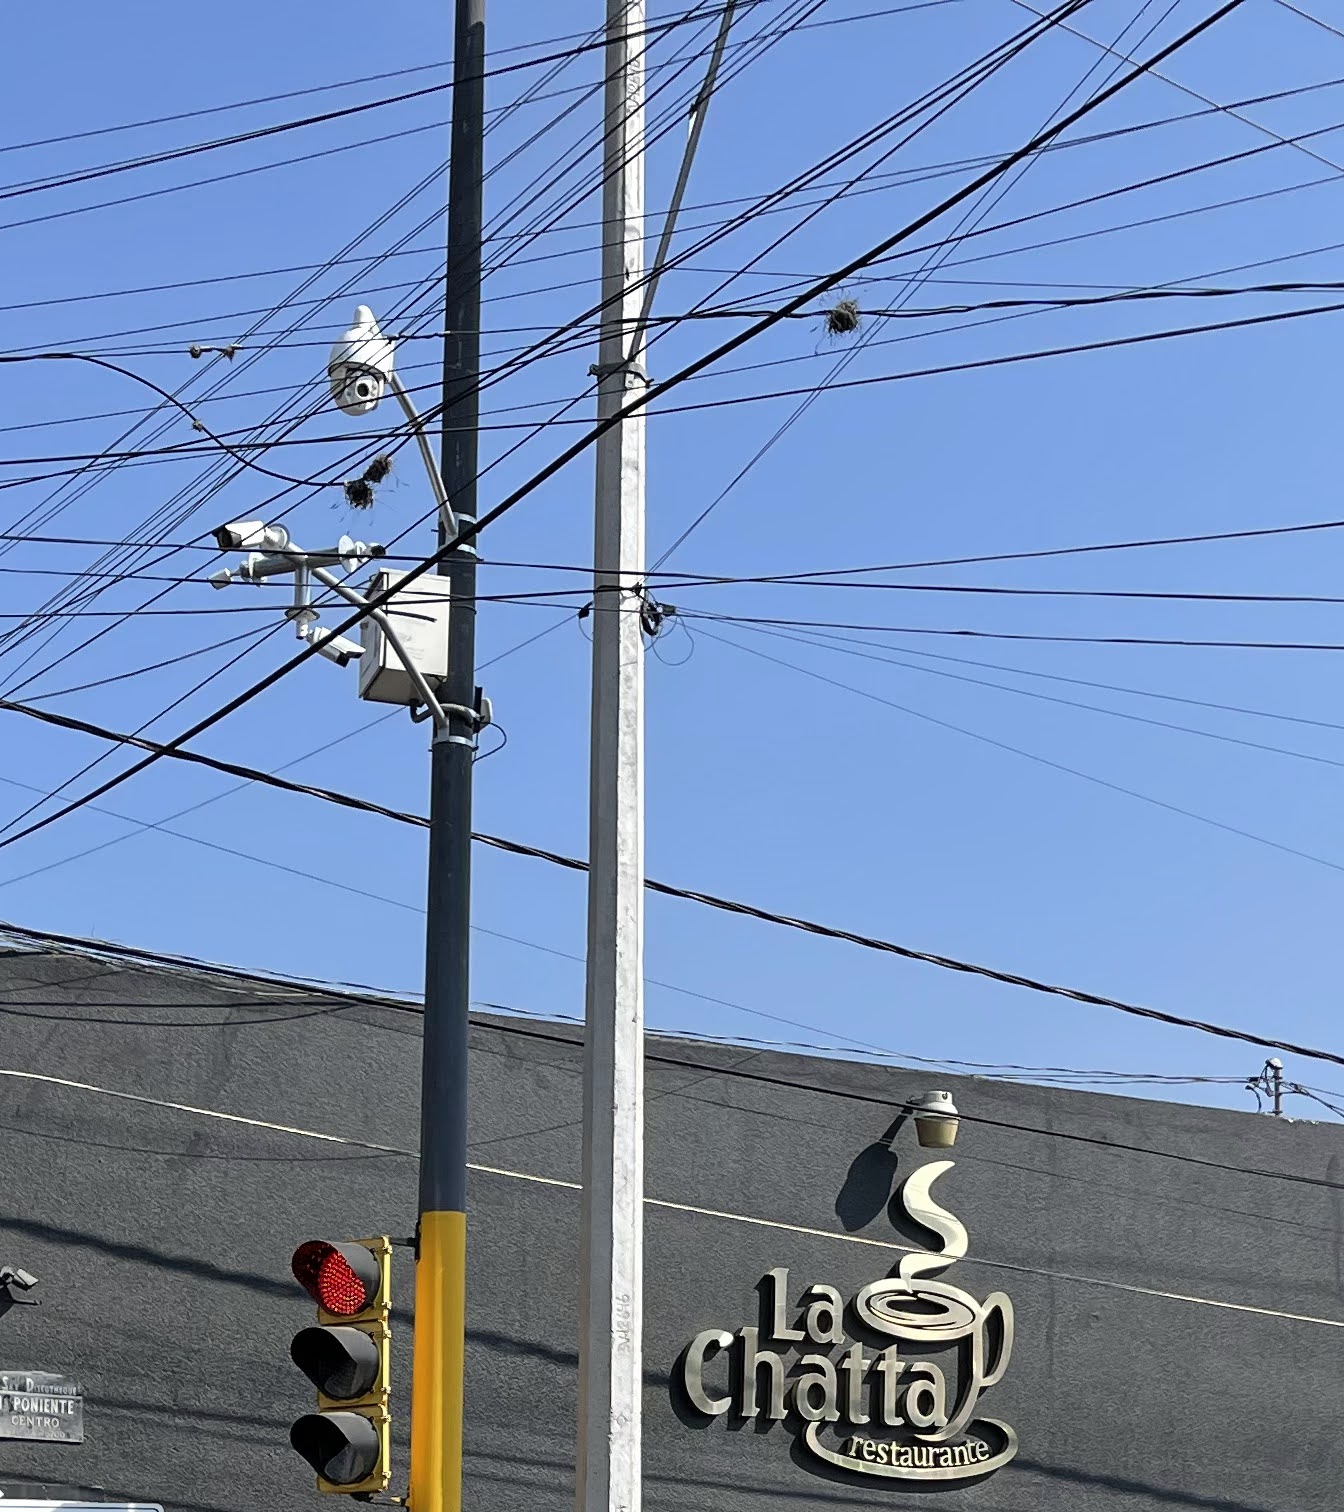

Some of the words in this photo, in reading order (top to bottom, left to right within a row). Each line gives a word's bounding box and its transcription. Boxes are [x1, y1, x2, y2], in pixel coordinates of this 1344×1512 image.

[768, 1268, 845, 1344] La
[685, 1327, 948, 1426] Chatta
[11, 1415, 60, 1428] CENTRO
[13, 1396, 75, 1415] PONIENTE
[849, 1435, 990, 1467] restaurante
